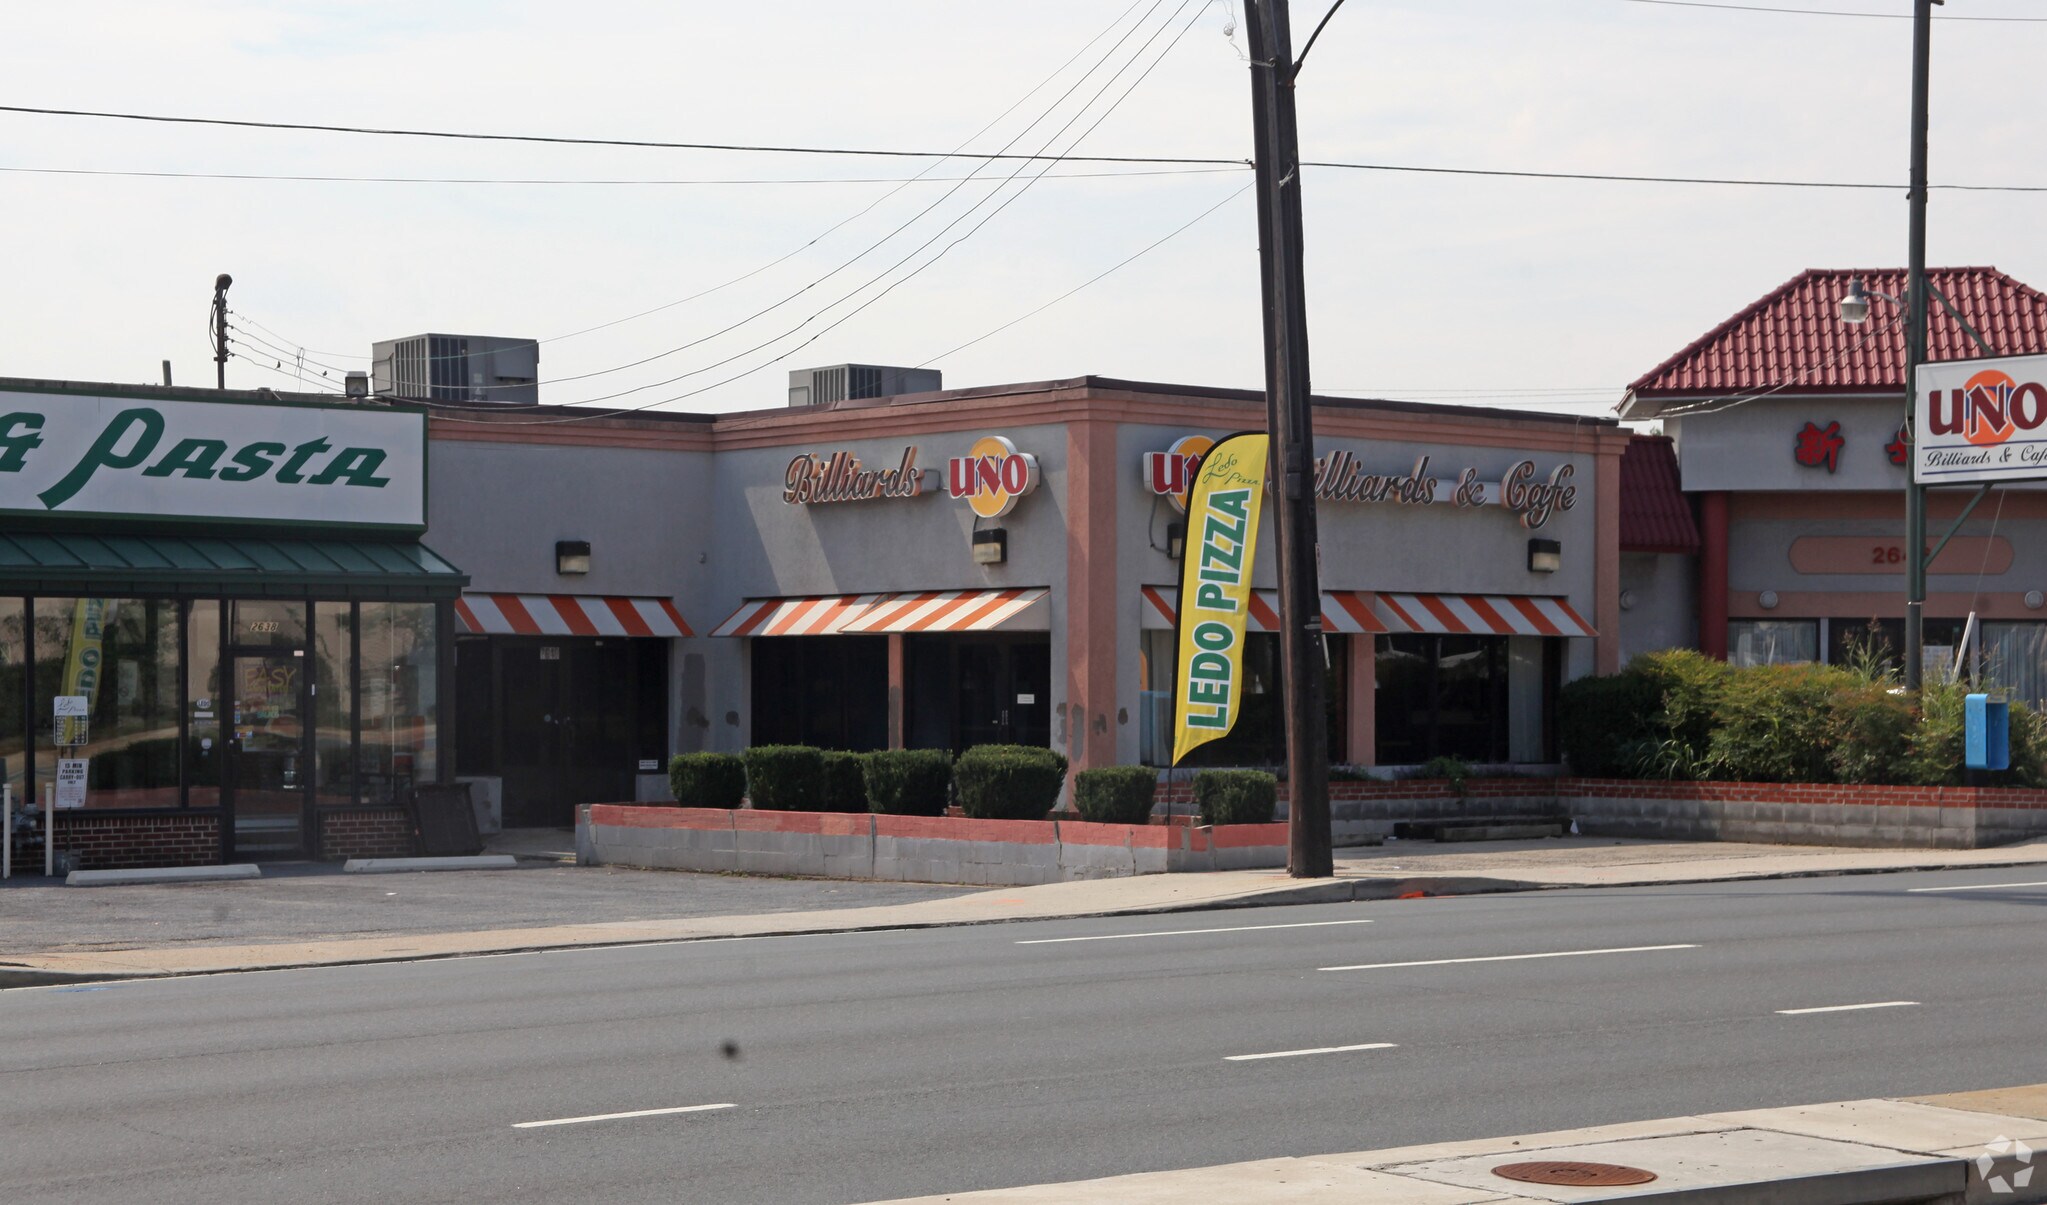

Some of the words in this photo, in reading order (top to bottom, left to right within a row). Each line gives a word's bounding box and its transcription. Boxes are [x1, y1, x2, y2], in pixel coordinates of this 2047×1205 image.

[1929, 377, 2047, 438] UNO
[37, 407, 391, 511] Pasta
[783, 446, 919, 504] Billiards
[949, 453, 1028, 499] UNO
[1202, 452, 1238, 484] Ledo
[1224, 472, 1258, 485] Pizza
[1924, 450, 1991, 467] Billiards
[1999, 446, 2012, 463] &
[1270, 450, 1438, 505] illiards
[1456, 467, 1487, 507] &
[1502, 460, 1577, 529] Cafe
[1195, 488, 1252, 613] PIZZA
[251, 622, 278, 631] 2638
[1187, 620, 1234, 731] LEDO
